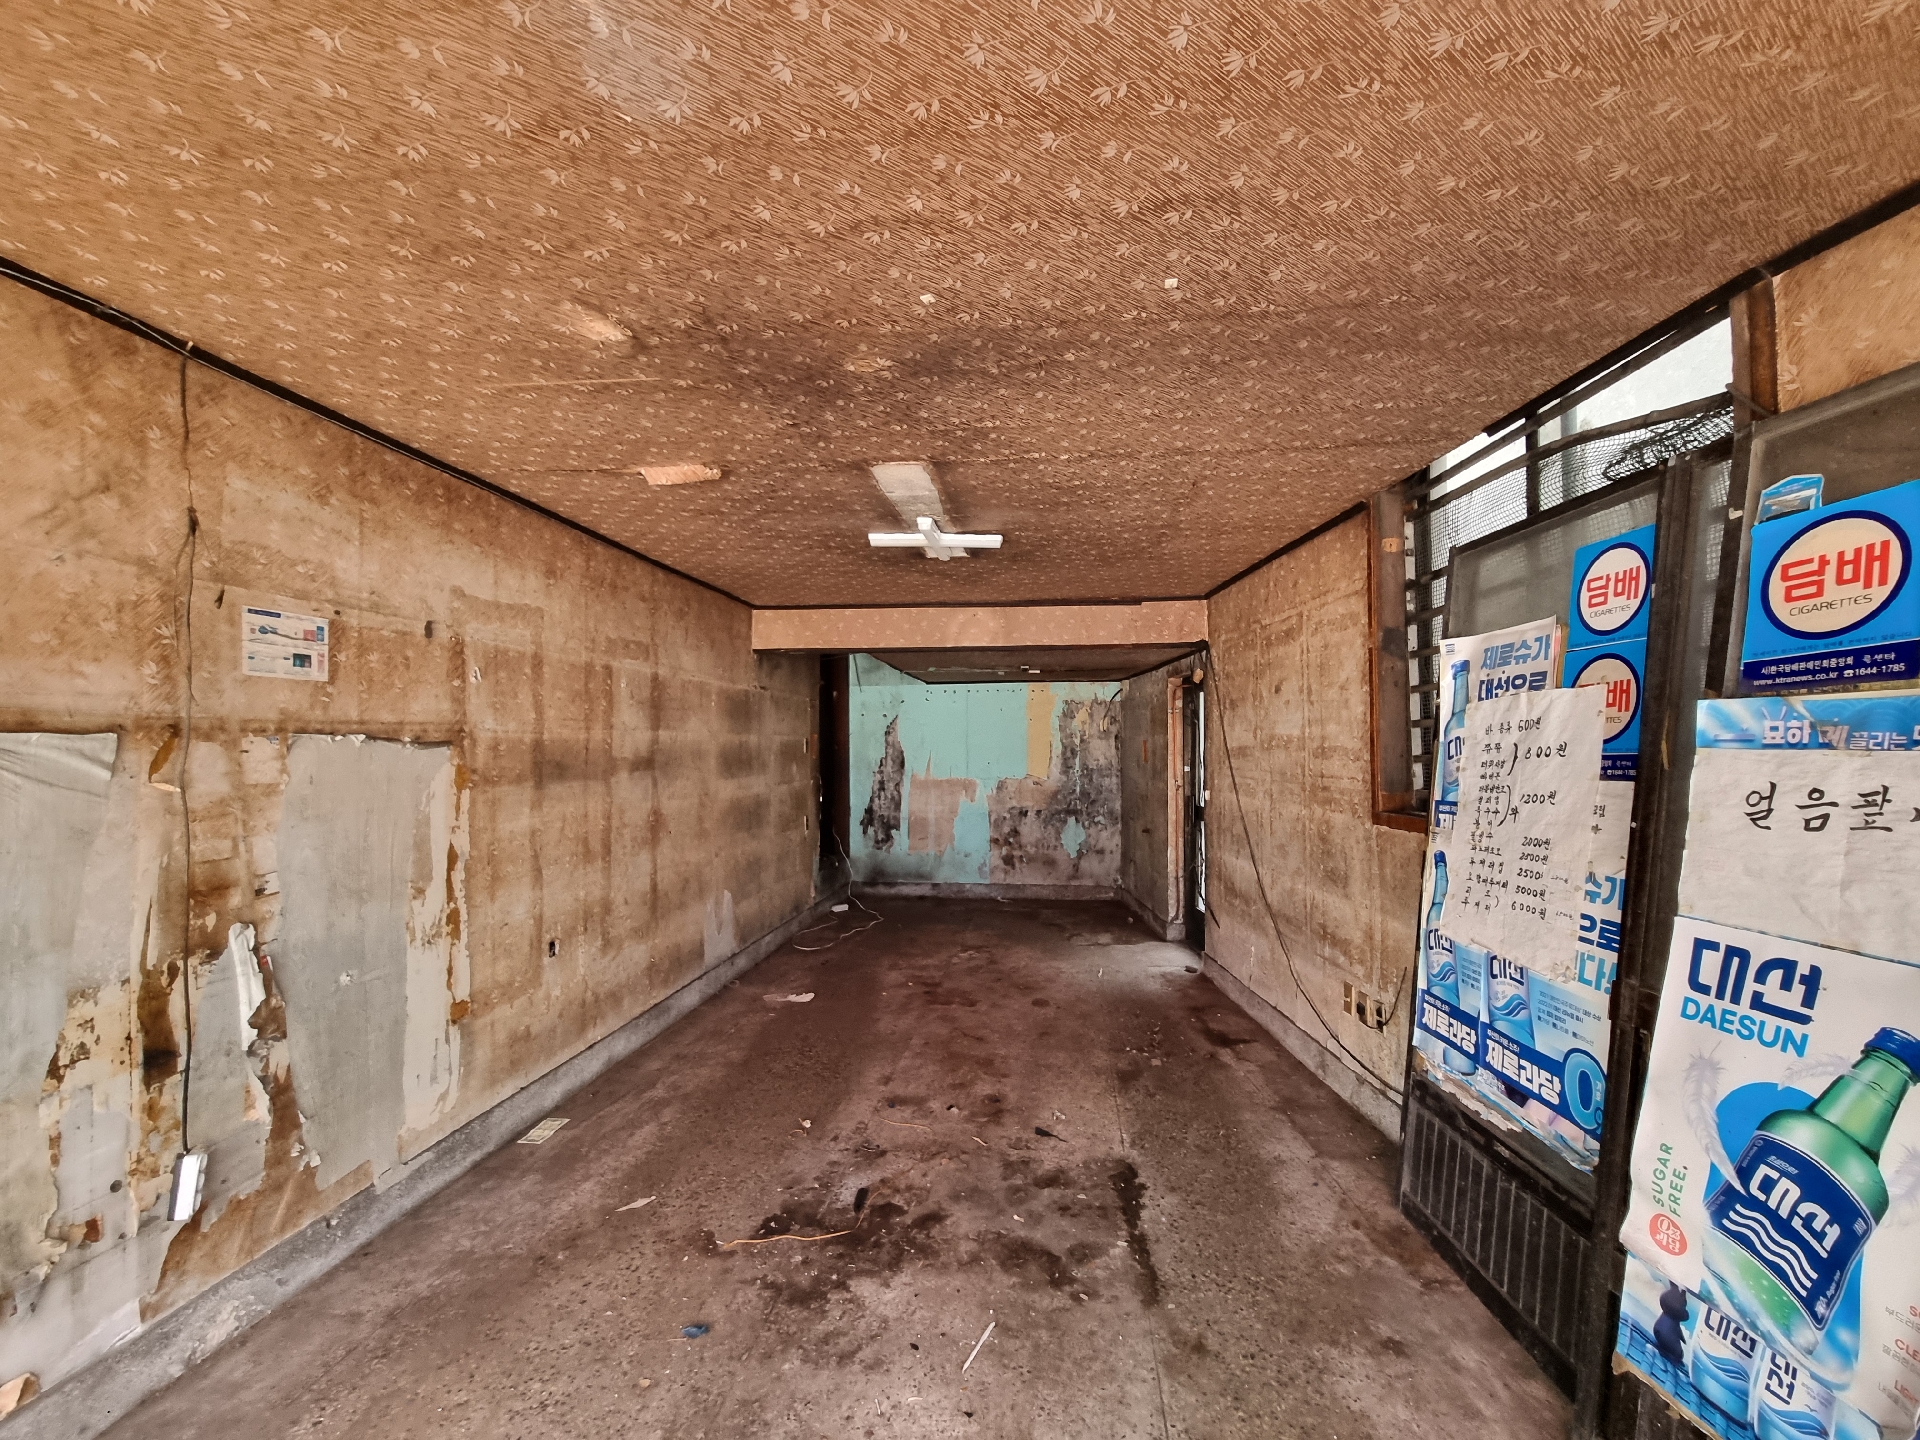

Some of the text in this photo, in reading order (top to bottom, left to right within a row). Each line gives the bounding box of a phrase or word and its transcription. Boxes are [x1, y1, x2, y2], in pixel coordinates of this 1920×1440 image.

[1780, 539, 1890, 603] 담배
[1587, 565, 1640, 608] 담배
[1590, 604, 1631, 618] CIGARETTES
[1790, 594, 1872, 616] CIGARETTES
[1481, 634, 1550, 670] 제로슈가
[1447, 736, 1466, 760] 대
[1524, 741, 1567, 760] 800원
[1519, 790, 1557, 806] 1200원
[1521, 836, 1552, 850] 2000원
[1518, 852, 1549, 865] 2500원
[1514, 885, 1547, 901] 5000원
[1511, 901, 1547, 920] 6000원
[1688, 937, 1822, 1025] 대선
[1422, 1002, 1477, 1055] 제로과당
[1680, 996, 1809, 1058] DAESUN
[1486, 1039, 1561, 1105] 제로과당
[1651, 1143, 1673, 1208] SUGAR
[1750, 1164, 1841, 1259] 대선
